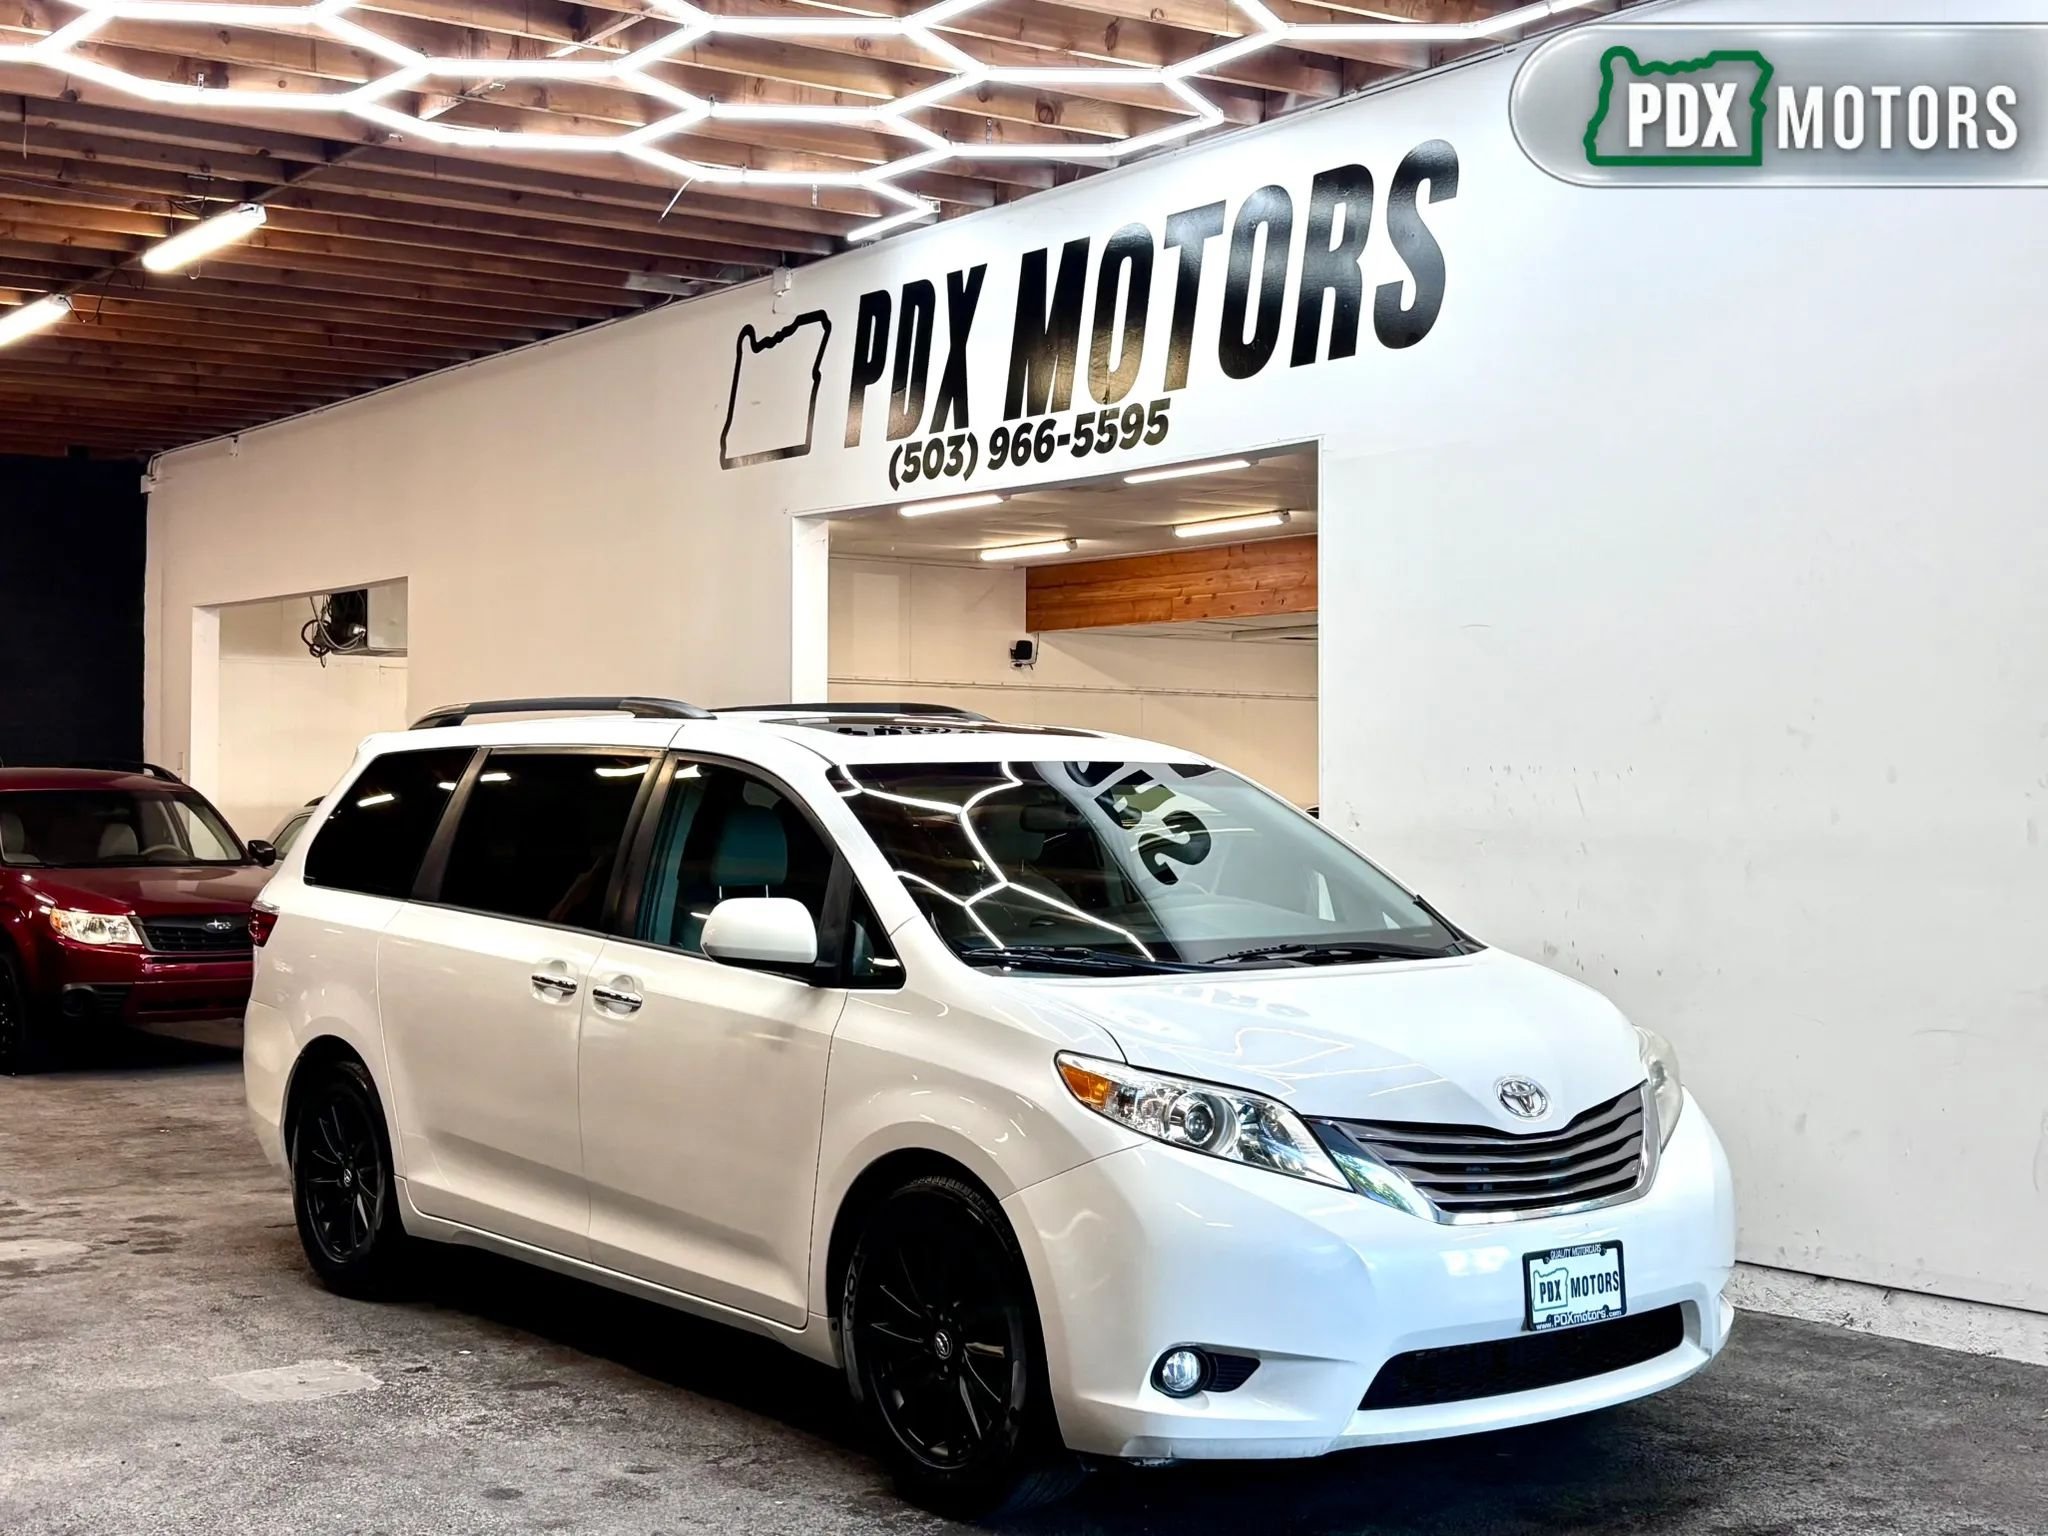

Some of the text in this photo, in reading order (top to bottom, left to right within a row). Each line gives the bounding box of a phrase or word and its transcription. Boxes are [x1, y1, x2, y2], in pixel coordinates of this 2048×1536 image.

[844, 138, 1460, 448] PDX MOTORS
[888, 397, 1172, 492] (503) 966-5595
[1539, 1270, 1619, 1304] PDX MOTORS
